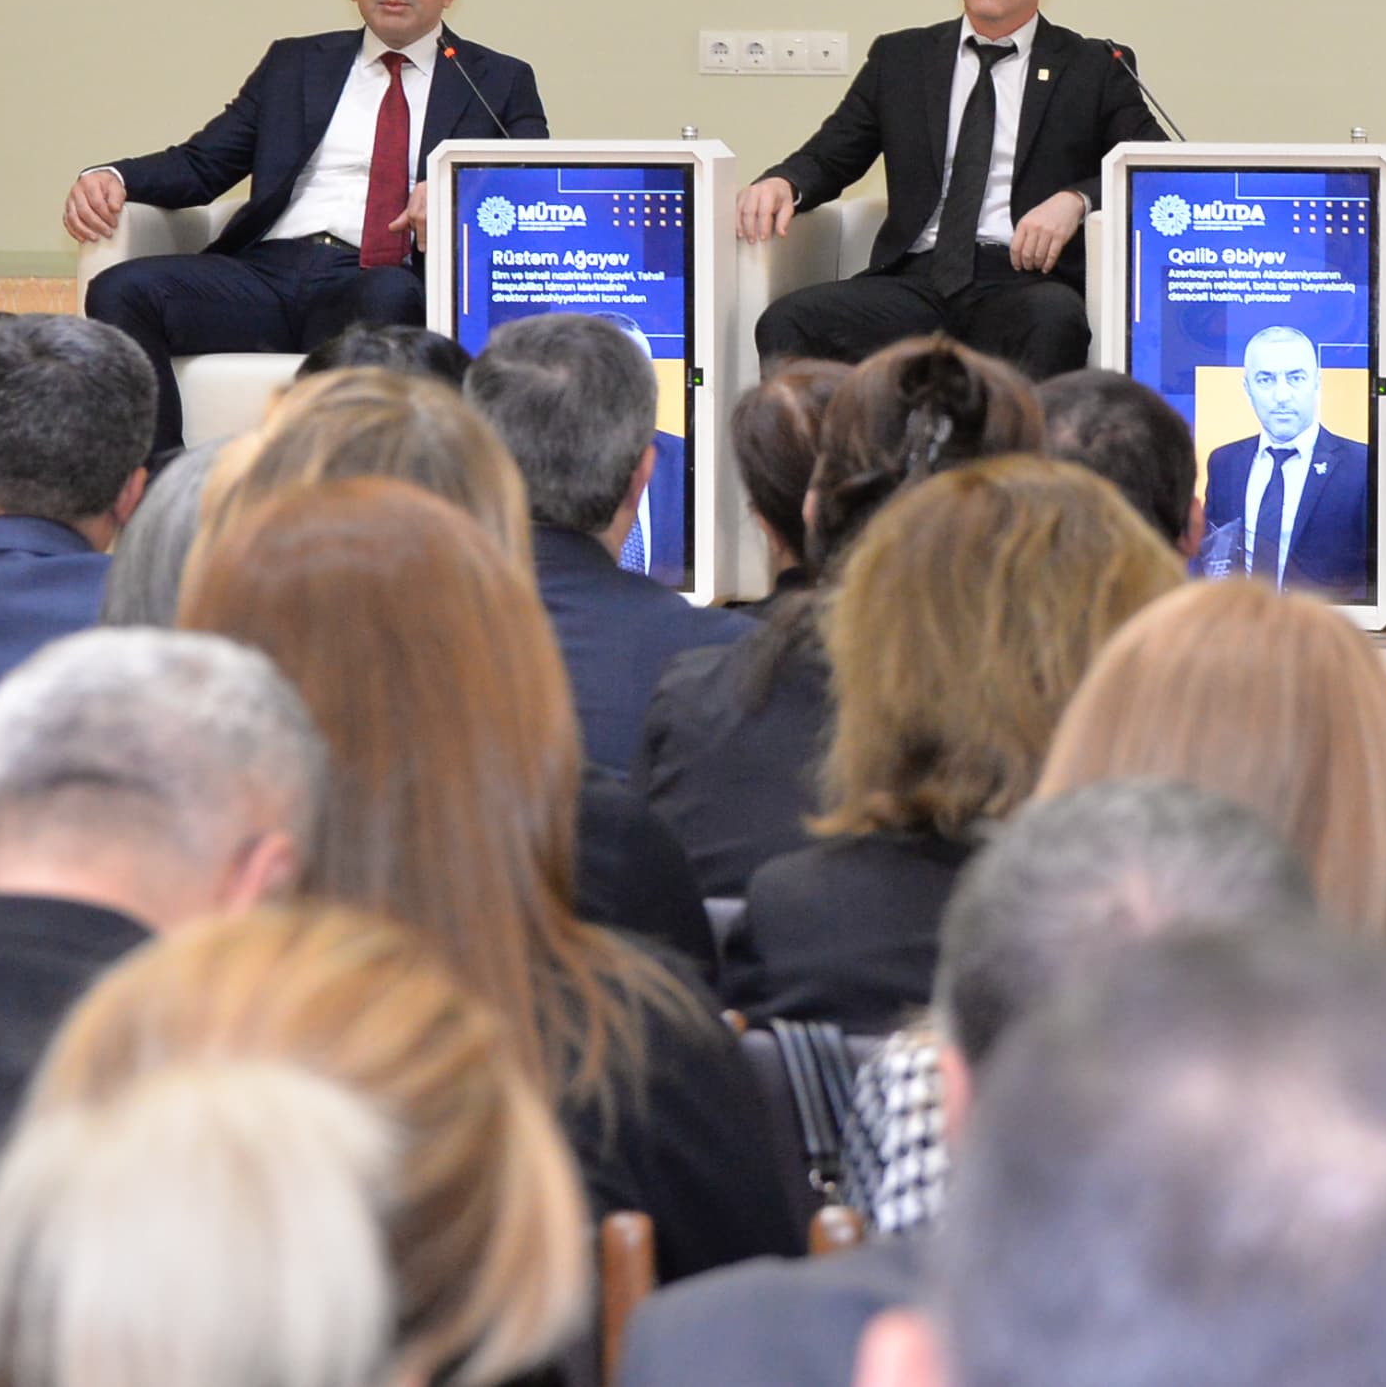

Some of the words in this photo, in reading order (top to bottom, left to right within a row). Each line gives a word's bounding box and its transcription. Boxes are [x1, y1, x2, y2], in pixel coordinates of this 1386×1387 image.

[518, 202, 586, 221] MÜTDA
[1193, 201, 1265, 220] MÜTDA
[492, 250, 558, 265] Rüstəm
[563, 250, 629, 270] Ağayev
[1168, 248, 1218, 265] Qalib
[1222, 248, 1286, 268] Əbiyev
